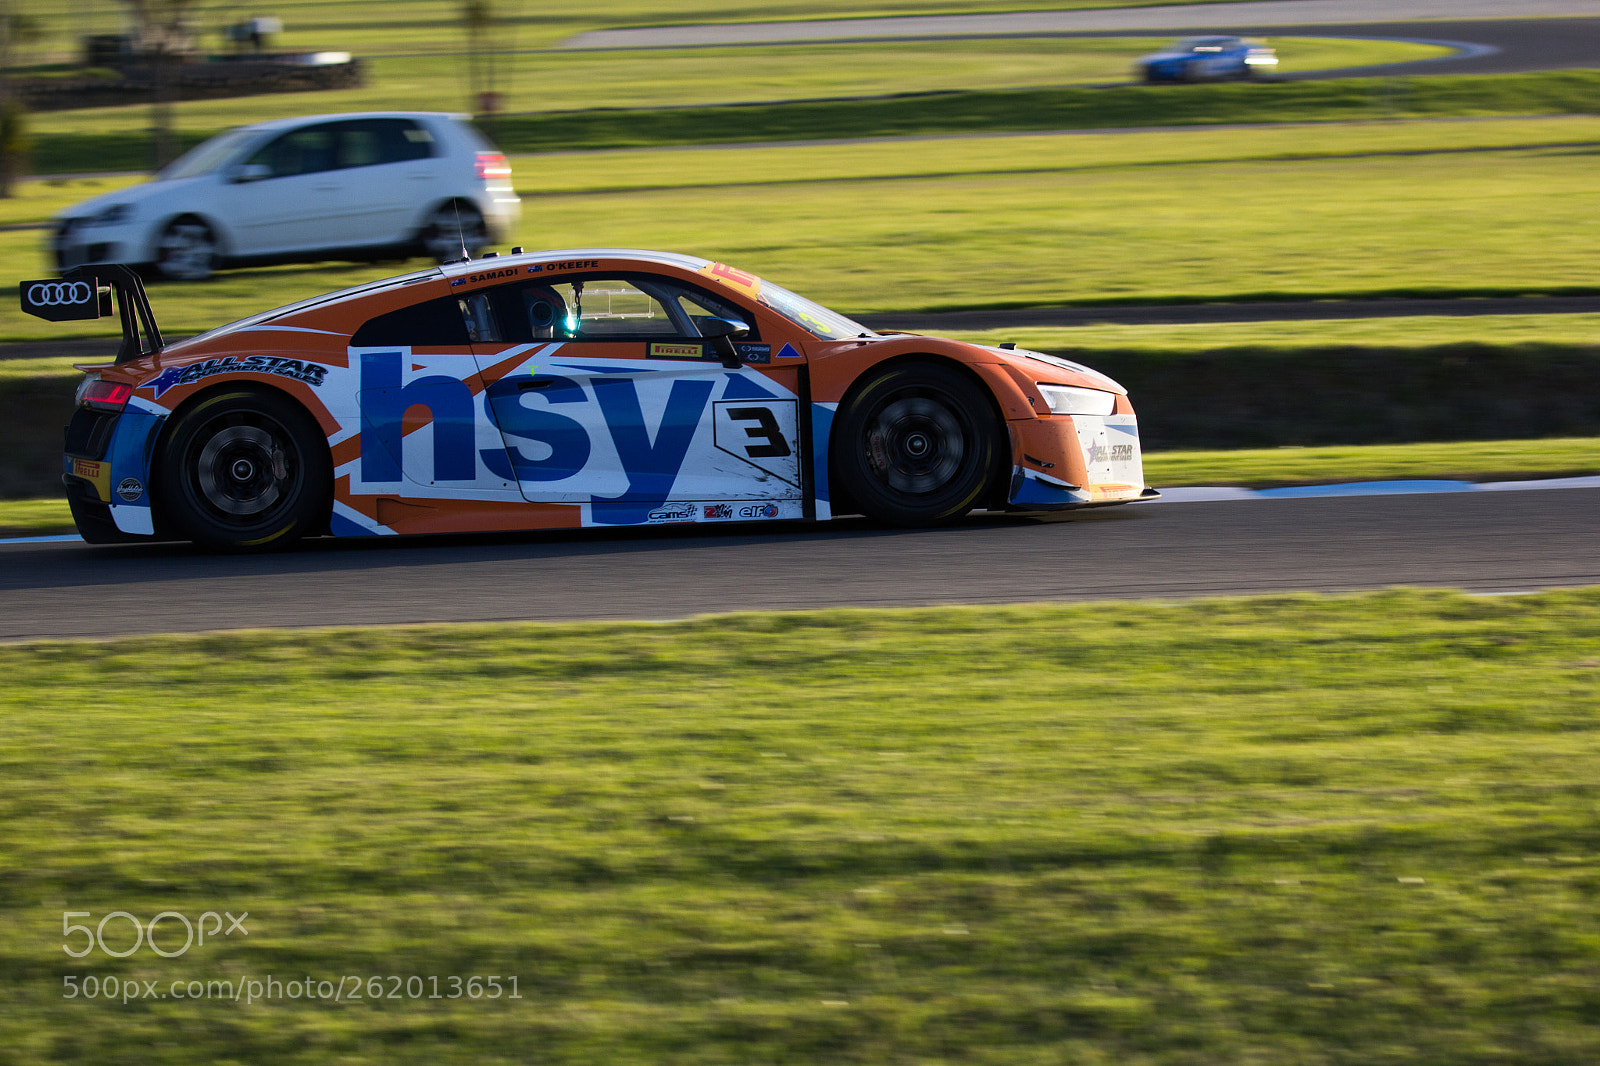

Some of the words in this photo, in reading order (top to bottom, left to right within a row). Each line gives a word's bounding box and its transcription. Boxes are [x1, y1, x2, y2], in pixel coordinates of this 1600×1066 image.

[546, 260, 599, 271] O'KEEFE
[469, 269, 519, 283] SAMADI
[654, 345, 698, 355] PIRELLI
[182, 356, 239, 377] ALL
[245, 355, 329, 379] STAR
[360, 352, 716, 524] hsy
[725, 406, 792, 458] 3
[1112, 444, 1133, 455] STAR
[75, 459, 100, 478] PIRELLI
